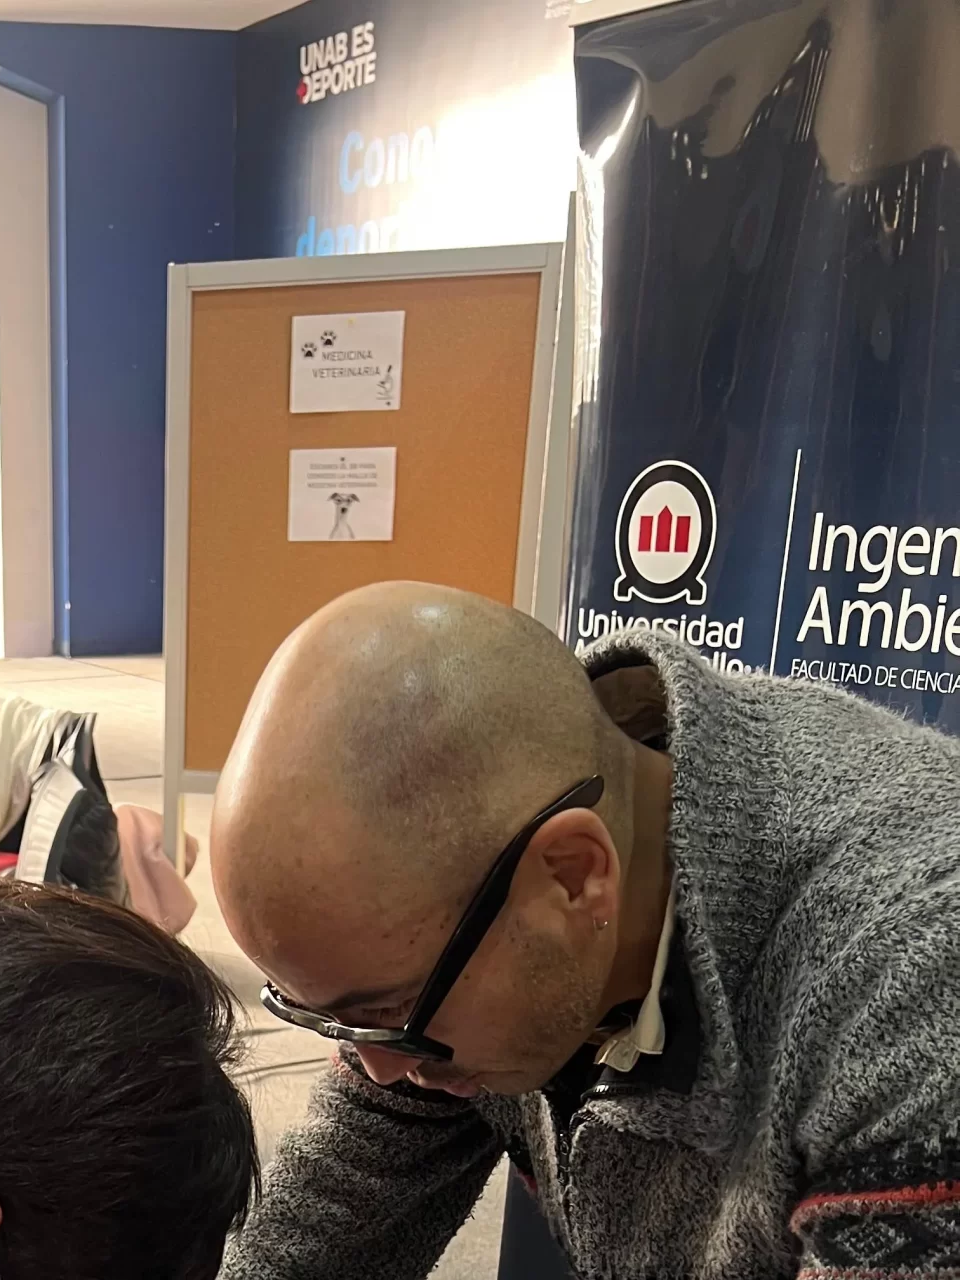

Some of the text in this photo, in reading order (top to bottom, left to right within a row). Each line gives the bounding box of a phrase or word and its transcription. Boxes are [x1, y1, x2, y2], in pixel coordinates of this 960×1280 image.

[300, 21, 375, 75] UNAB ES
[297, 51, 377, 104] DEPORTE
[312, 367, 381, 379] VETERINARIA
[321, 350, 374, 362] MEDICINA
[809, 512, 960, 593] Ingen
[791, 659, 871, 685] FACULTAD
[875, 666, 898, 688] DE
